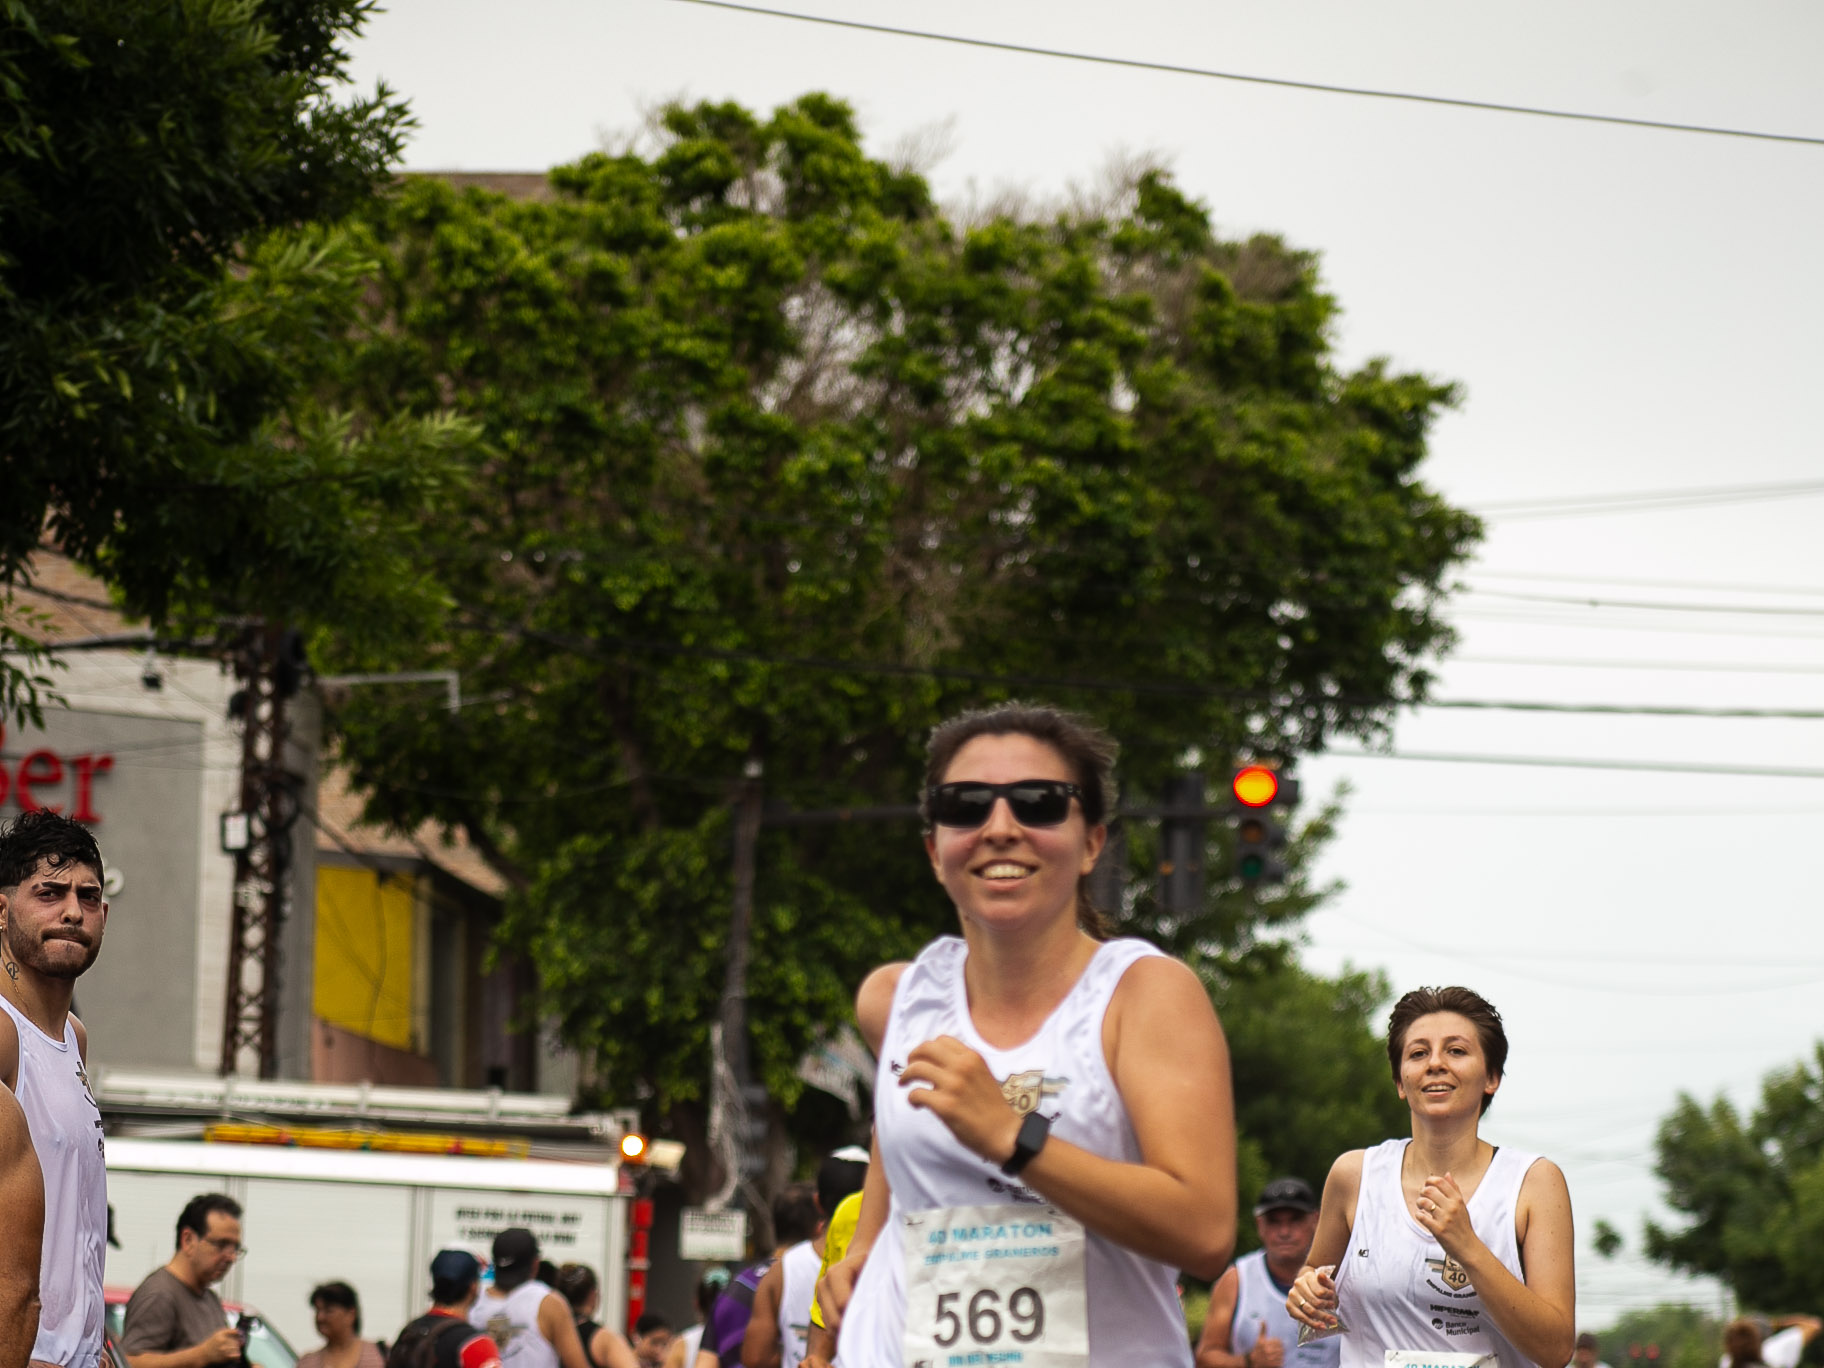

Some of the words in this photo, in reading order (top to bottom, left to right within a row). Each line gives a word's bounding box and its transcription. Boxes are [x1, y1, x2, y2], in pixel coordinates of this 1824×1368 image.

[0, 721, 114, 823] er
[929, 1229, 947, 1244] 40
[953, 1223, 1052, 1242] MARATON
[1449, 1272, 1467, 1283] 40
[934, 1287, 1044, 1347] 569
[1446, 1326, 1480, 1336] Municipal
